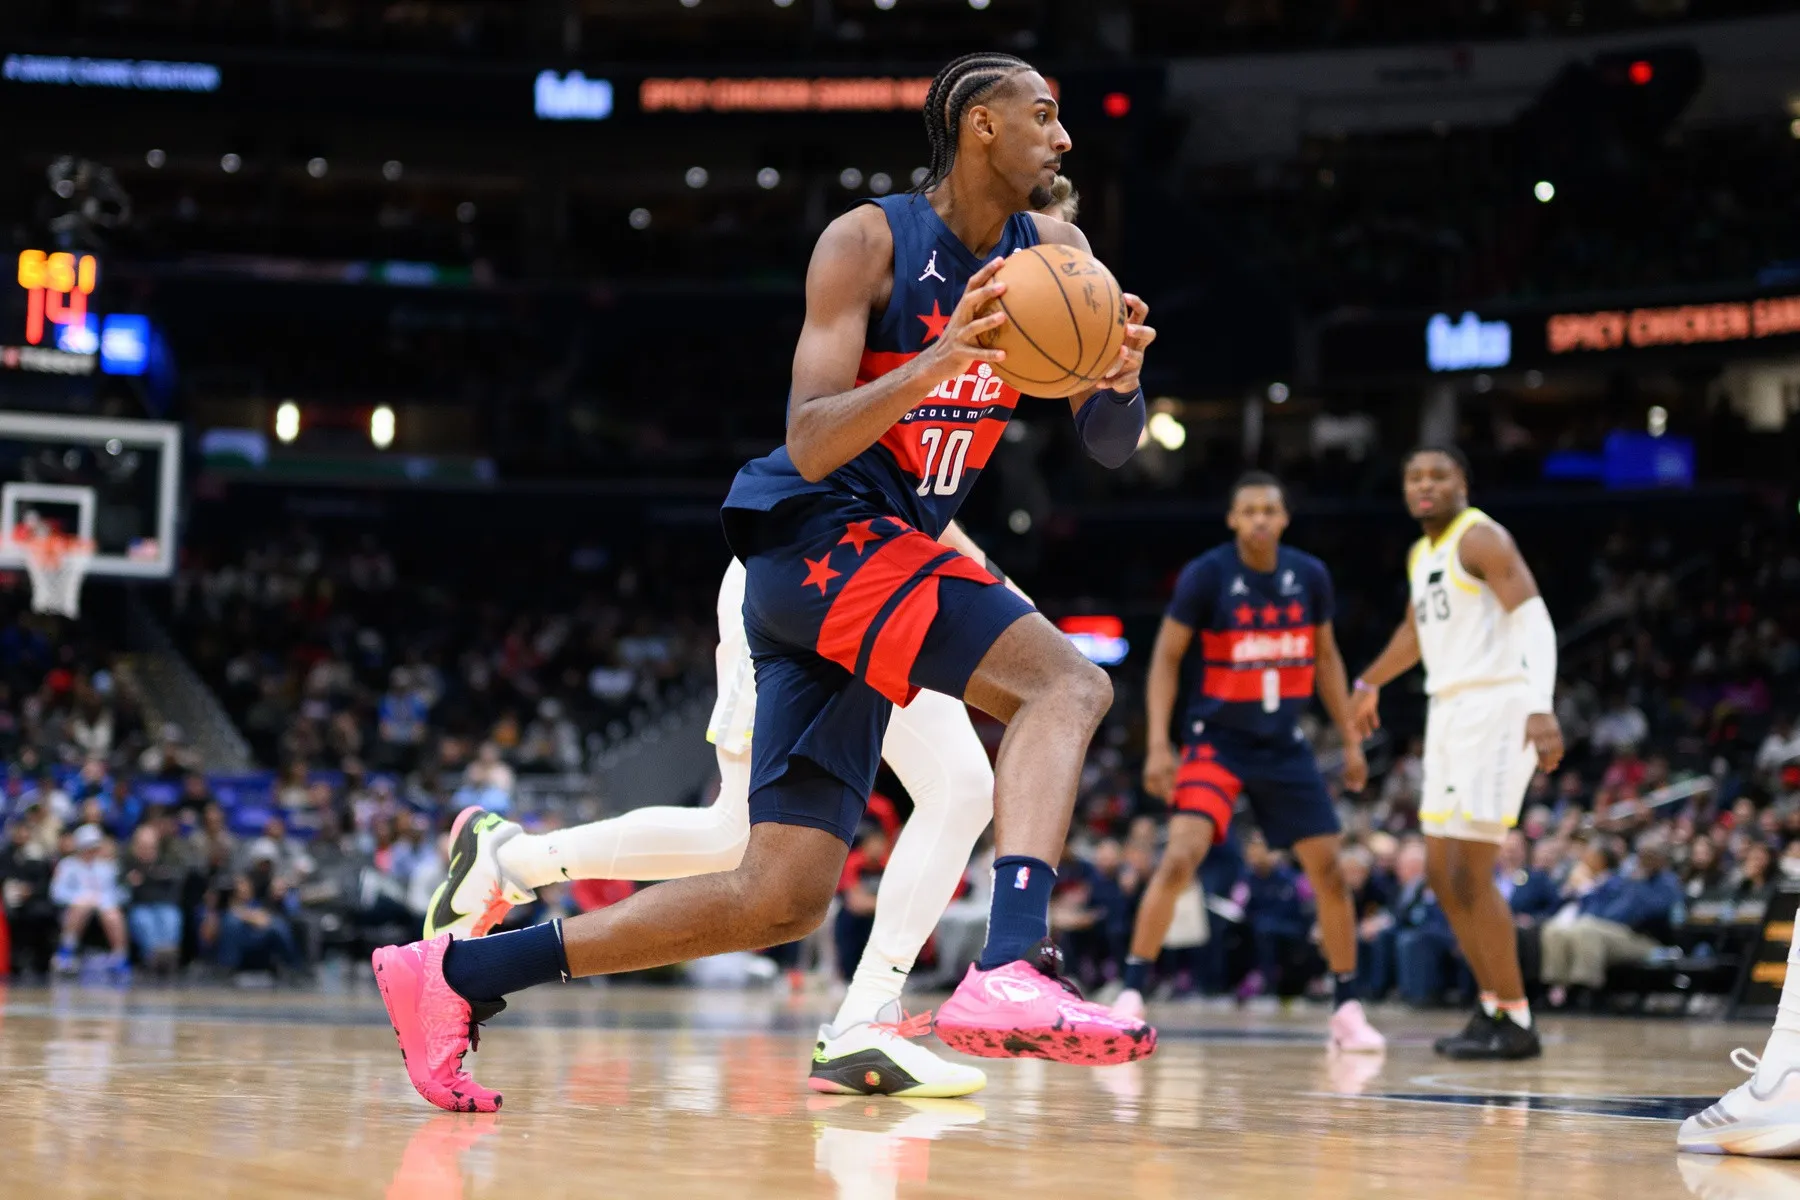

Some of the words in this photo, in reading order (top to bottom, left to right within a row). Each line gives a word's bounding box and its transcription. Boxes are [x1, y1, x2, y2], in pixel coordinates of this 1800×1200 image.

[1548, 313, 1626, 352] SPICY
[1628, 302, 1749, 347] CHICKEN
[916, 428, 974, 497] 20
